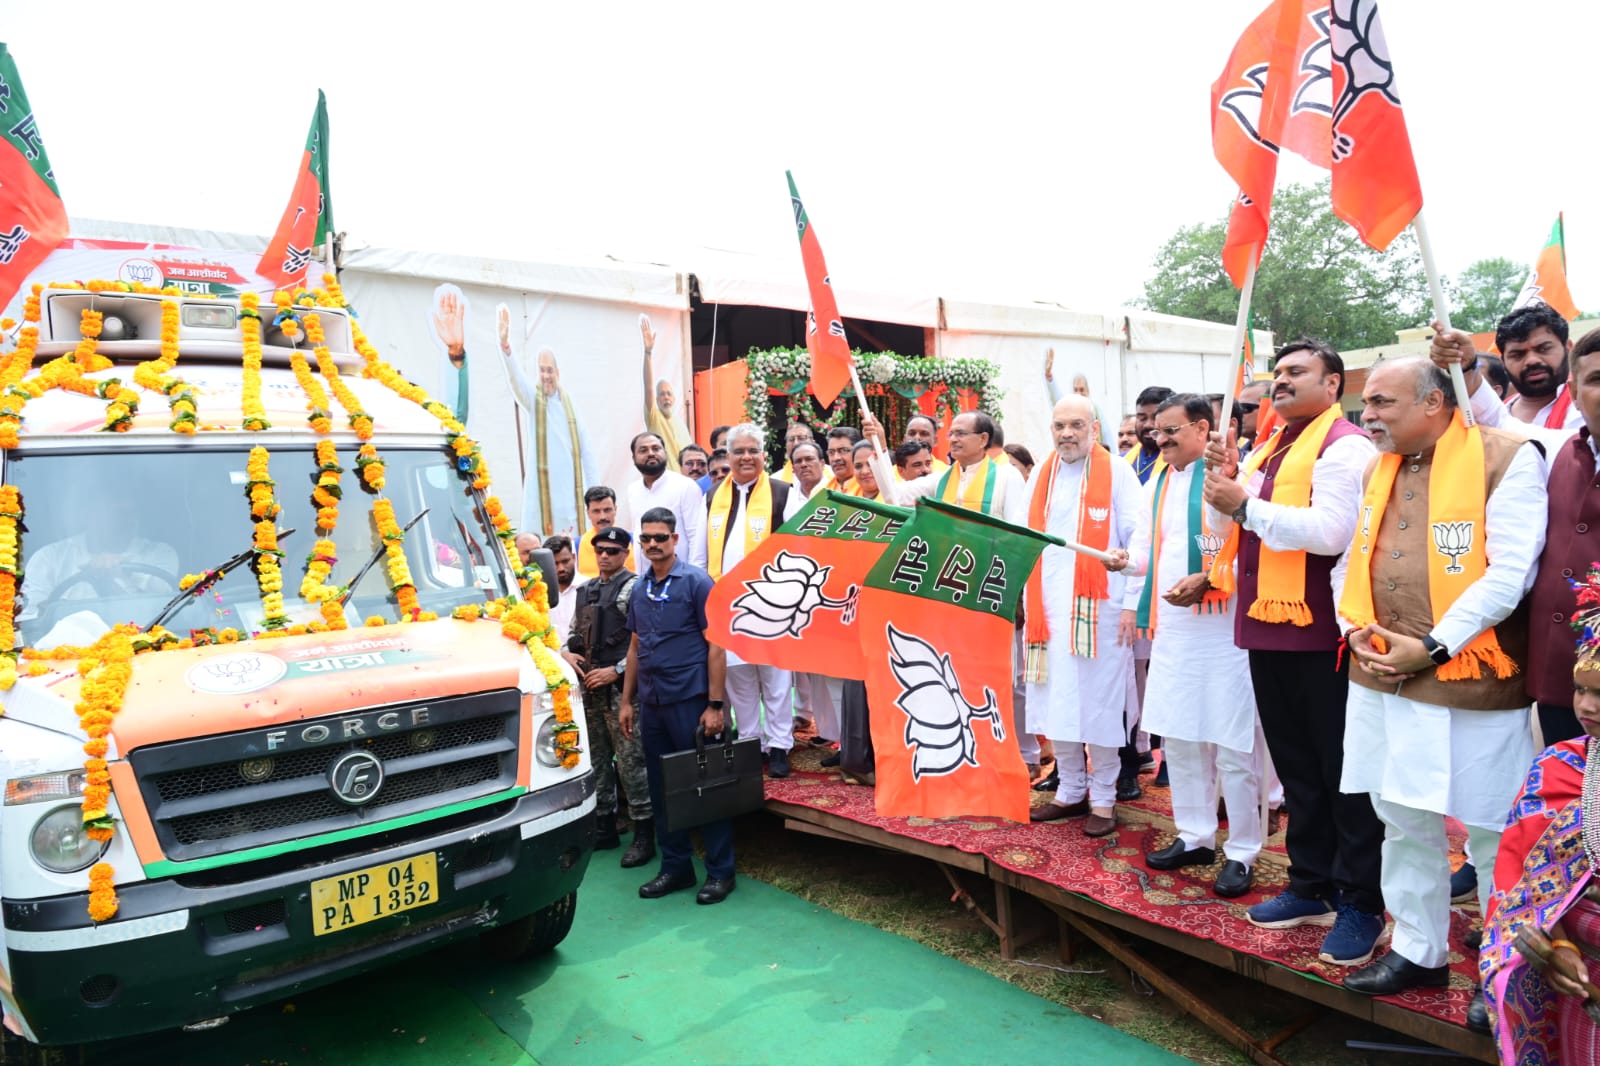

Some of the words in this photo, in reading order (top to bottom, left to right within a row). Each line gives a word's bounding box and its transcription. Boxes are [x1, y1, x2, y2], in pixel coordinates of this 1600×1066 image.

[168, 267, 185, 276] जन
[296, 651, 385, 672] यात्रा
[266, 707, 430, 750] FORCE
[338, 873, 370, 902] MP
[388, 862, 415, 887] 04
[322, 902, 355, 930] PA
[373, 881, 430, 916] 1352
